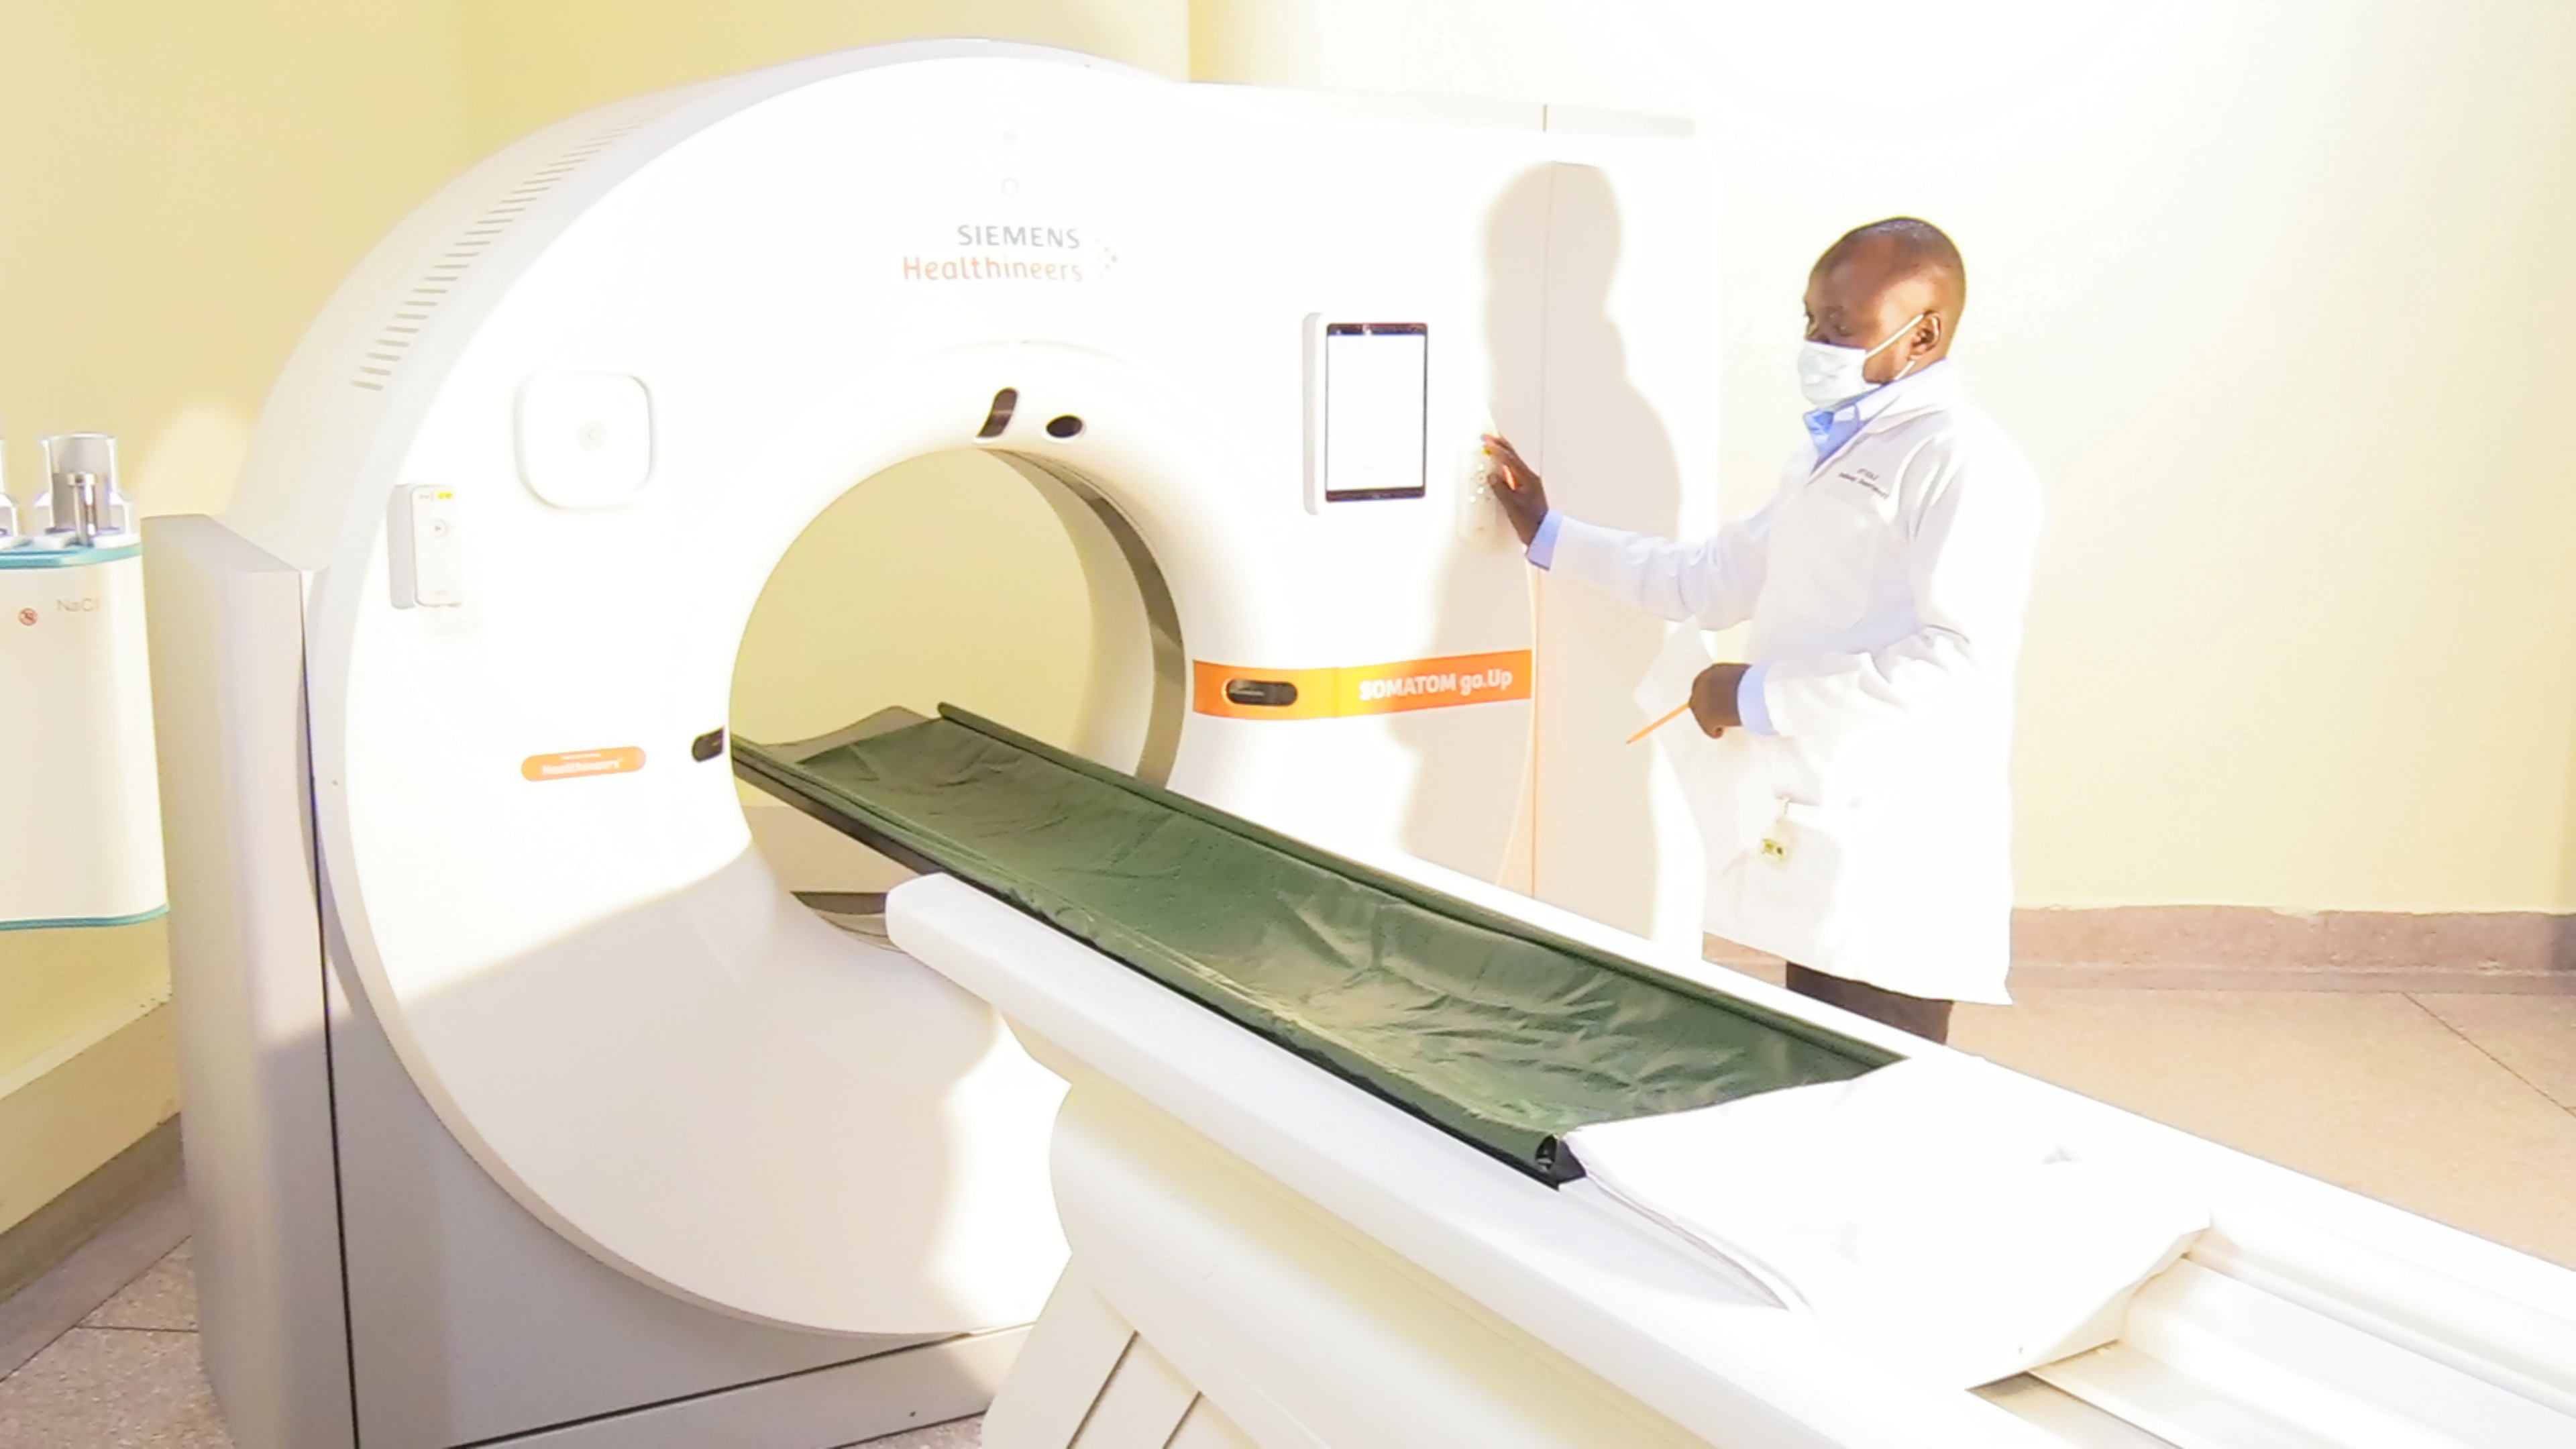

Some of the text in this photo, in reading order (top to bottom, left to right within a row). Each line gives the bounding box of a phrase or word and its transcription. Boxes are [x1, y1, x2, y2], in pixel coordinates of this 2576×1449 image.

[957, 224, 1081, 250] SIEMENS
[902, 255, 1083, 282] Healthineers
[56, 597, 101, 612] NaCl
[1358, 669, 1513, 701] SOMATOM go.Up
